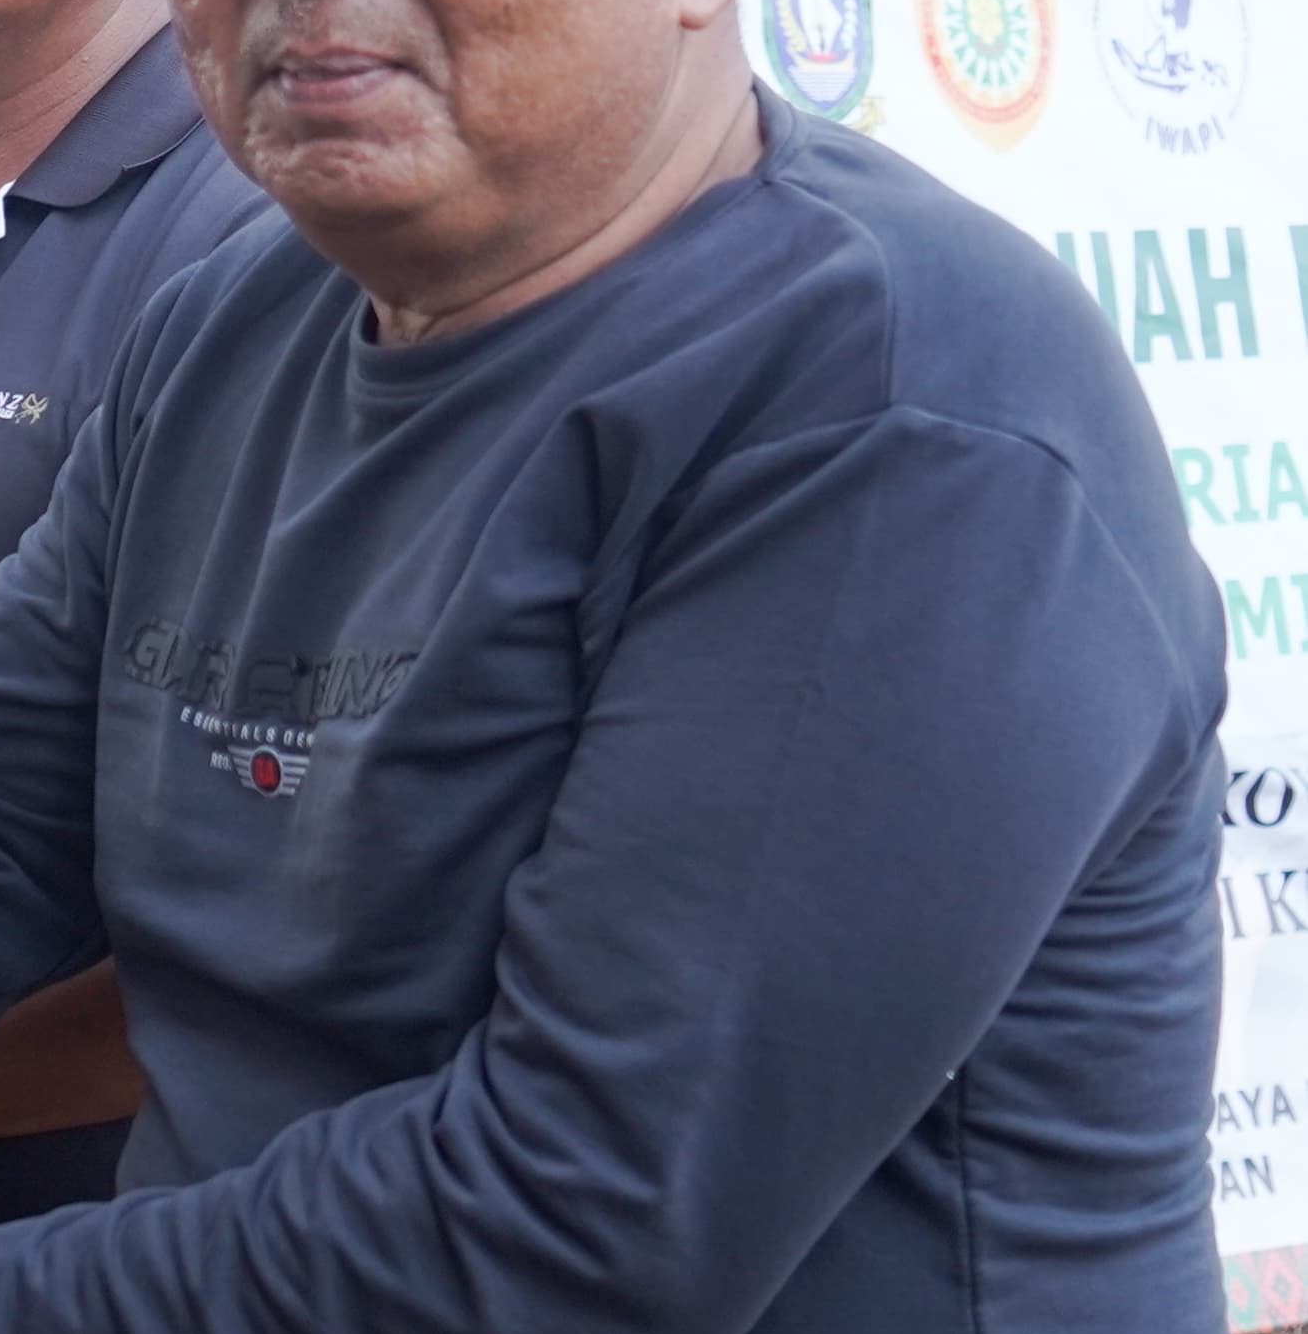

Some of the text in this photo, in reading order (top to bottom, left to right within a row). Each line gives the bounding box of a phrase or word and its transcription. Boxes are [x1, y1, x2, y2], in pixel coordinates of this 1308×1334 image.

[1145, 114, 1225, 155] IWAPI
[1216, 1084, 1297, 1134] AYA
[1220, 1154, 1276, 1202] AN
